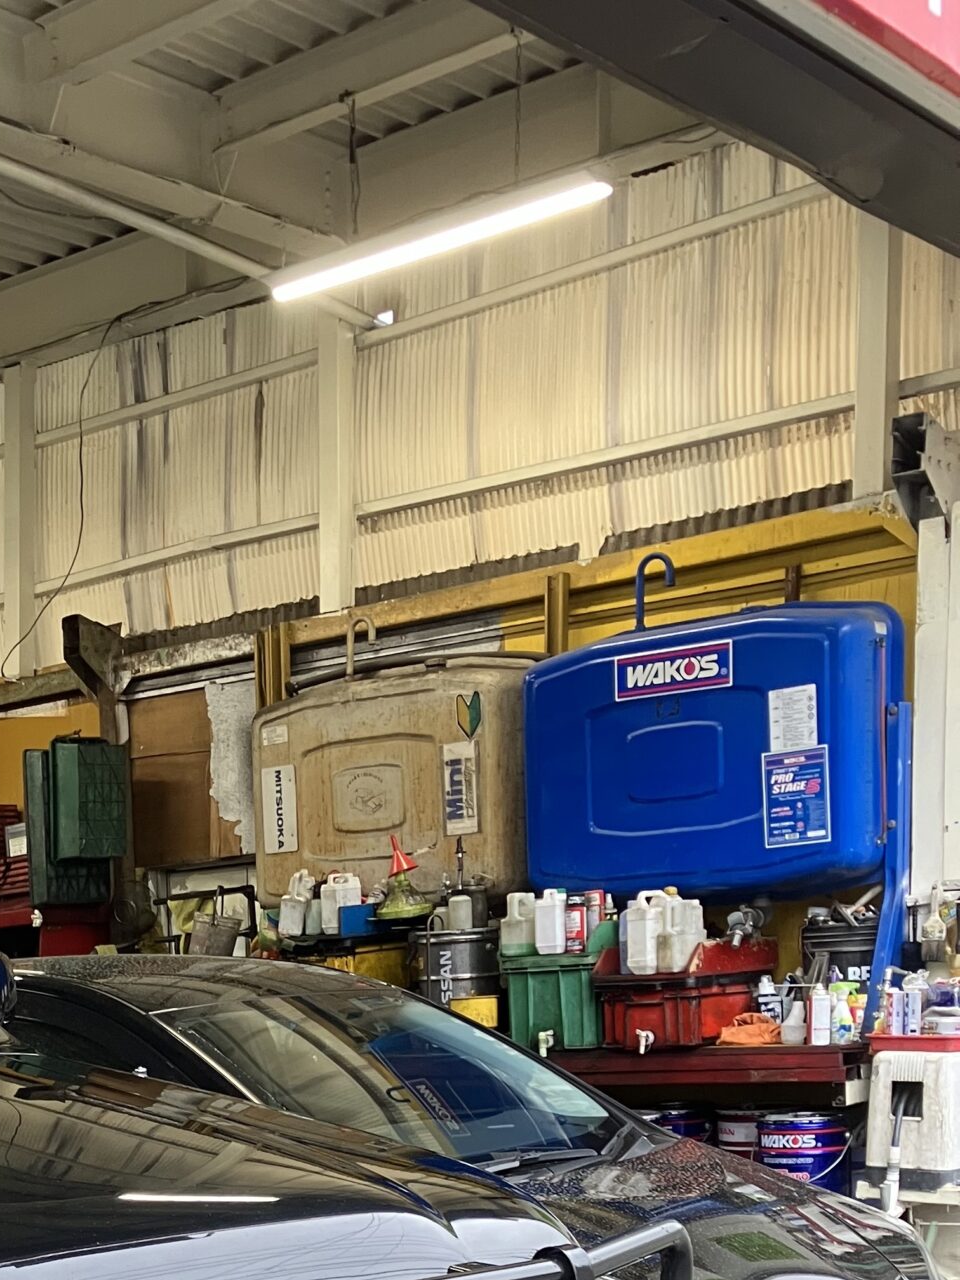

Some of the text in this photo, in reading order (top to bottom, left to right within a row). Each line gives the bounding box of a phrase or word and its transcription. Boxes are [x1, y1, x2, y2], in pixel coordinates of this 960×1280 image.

[445, 758, 465, 820] Mini
[770, 773, 794, 785] PRO
[772, 780, 808, 794] STAGE
[274, 769, 285, 850] MITSUOKA
[439, 950, 453, 1004] SSAN
